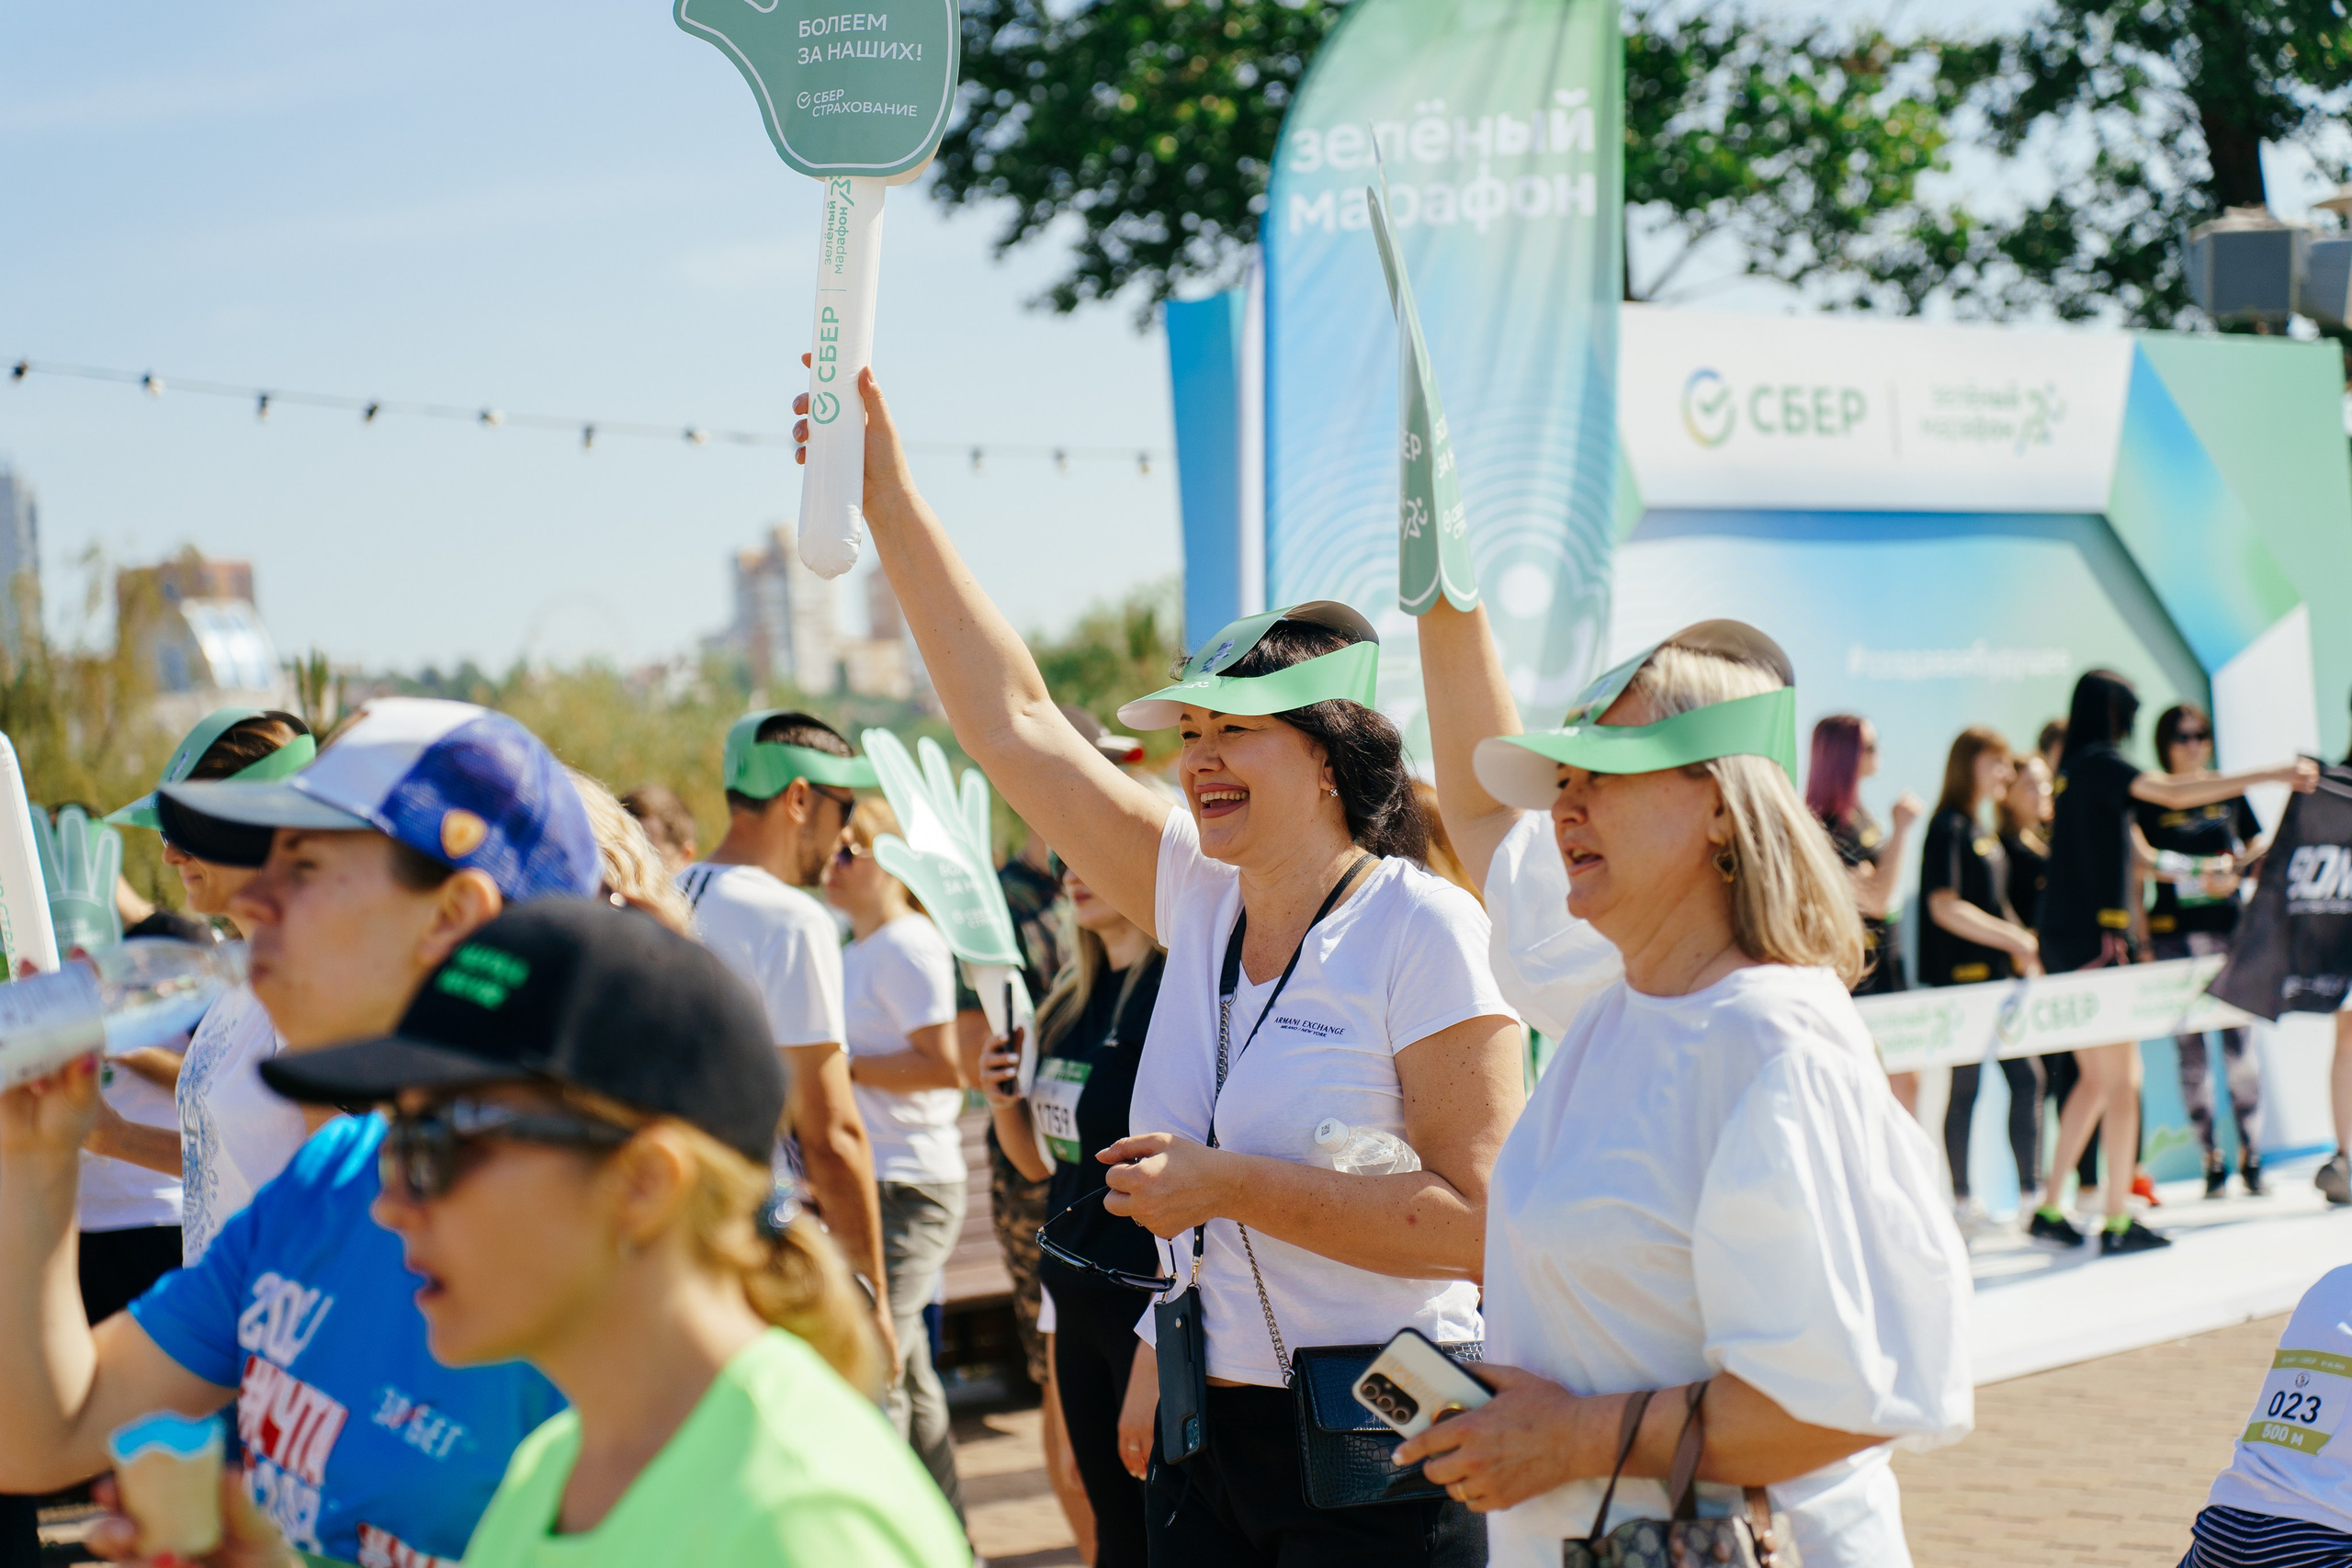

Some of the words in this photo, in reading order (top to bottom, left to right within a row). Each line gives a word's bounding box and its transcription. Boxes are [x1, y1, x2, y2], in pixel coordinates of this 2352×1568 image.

[798, 14, 888, 38] БОЛЕЕМ
[797, 46, 823, 65] ЗА
[827, 40, 922, 62] НАШИХ!
[811, 101, 918, 118] СТРАХОВАНИЕ
[813, 89, 844, 105] СБЕР
[1289, 89, 1596, 173] зелёный
[824, 200, 837, 265] зелёный
[834, 206, 850, 275] марафон
[818, 306, 840, 383] СБЕР
[1749, 385, 1868, 436] СБЕР
[1274, 1017, 1300, 1025] ARMANI
[1302, 1021, 1345, 1034] EXCHANGE
[2267, 1391, 2322, 1423] 023
[2262, 1423, 2289, 1441] 500
